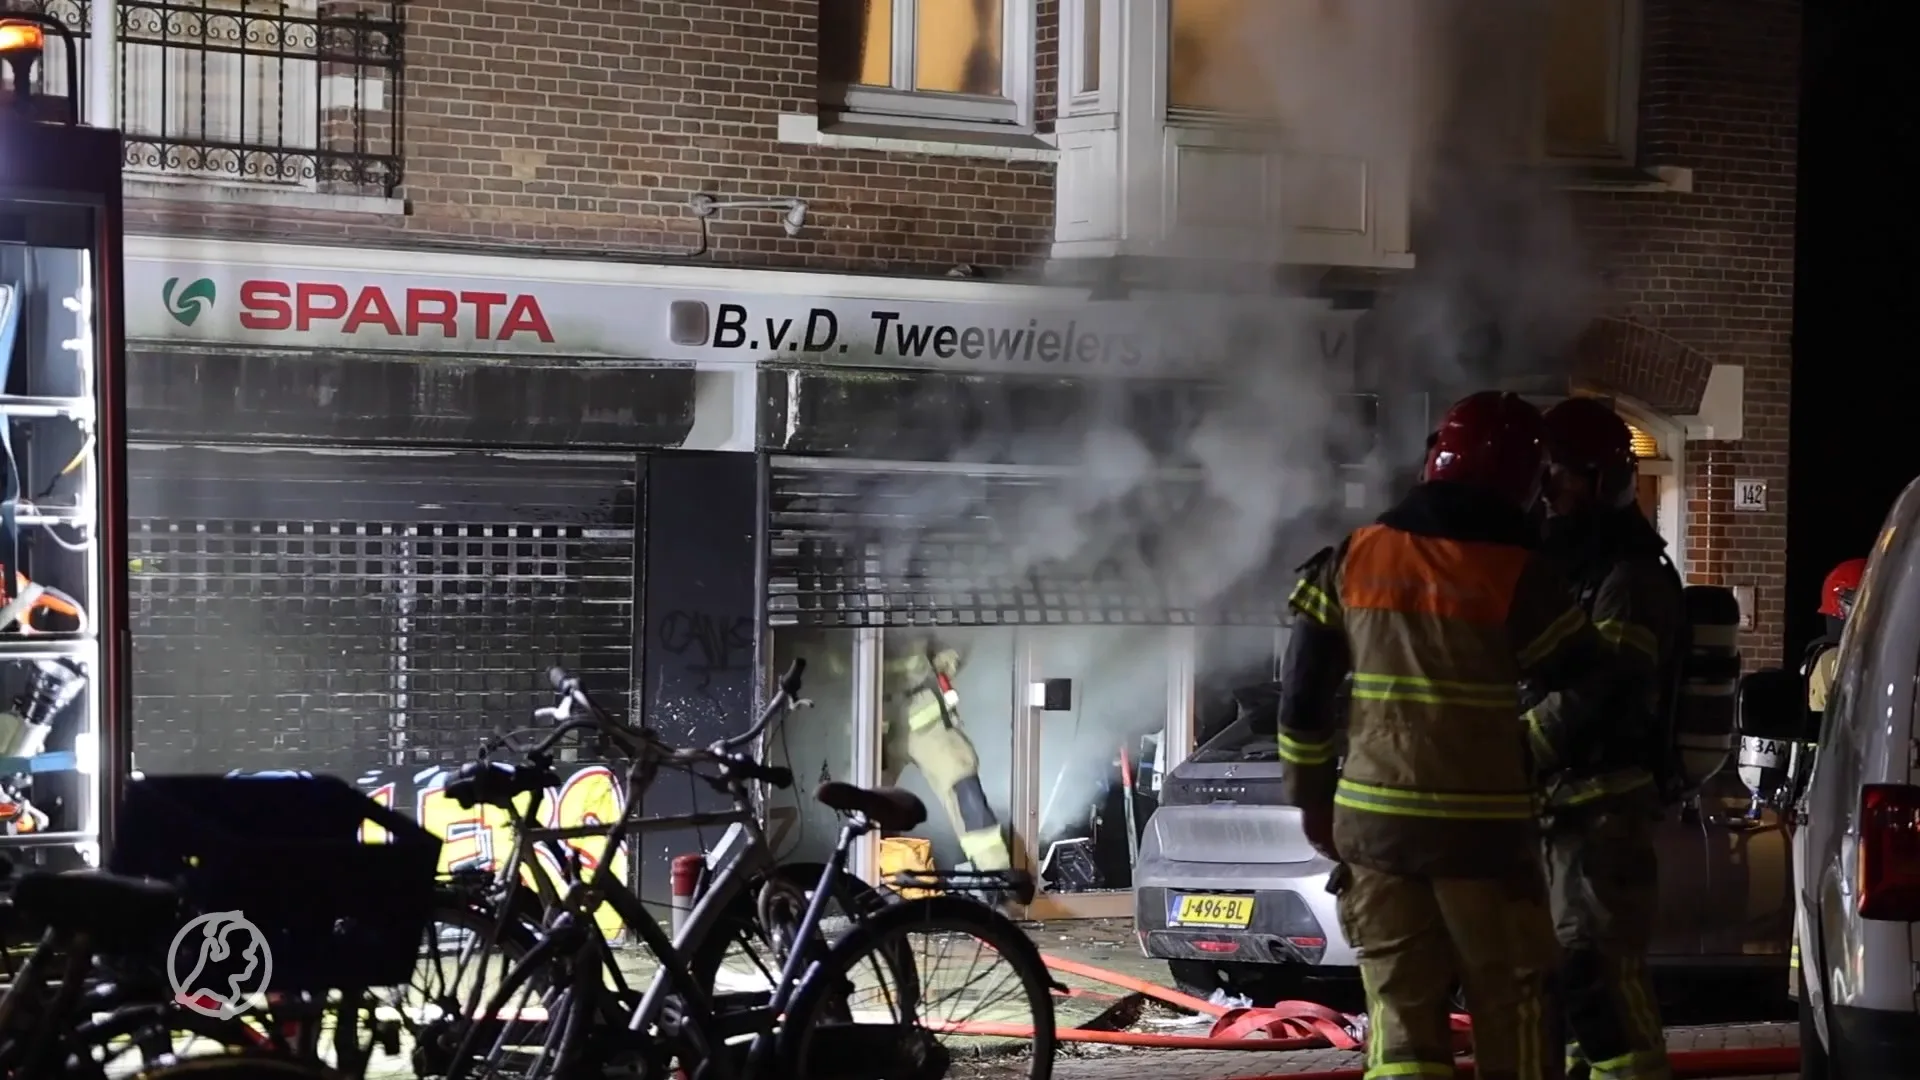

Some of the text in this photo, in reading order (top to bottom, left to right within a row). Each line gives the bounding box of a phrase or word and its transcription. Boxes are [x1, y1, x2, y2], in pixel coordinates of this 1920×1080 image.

[238, 279, 556, 343] SPARTA
[711, 303, 849, 354] B.v.D.
[870, 310, 1143, 367] Tweewielers
[1741, 484, 1763, 505] 142
[1181, 899, 1244, 920] J-496-BL
